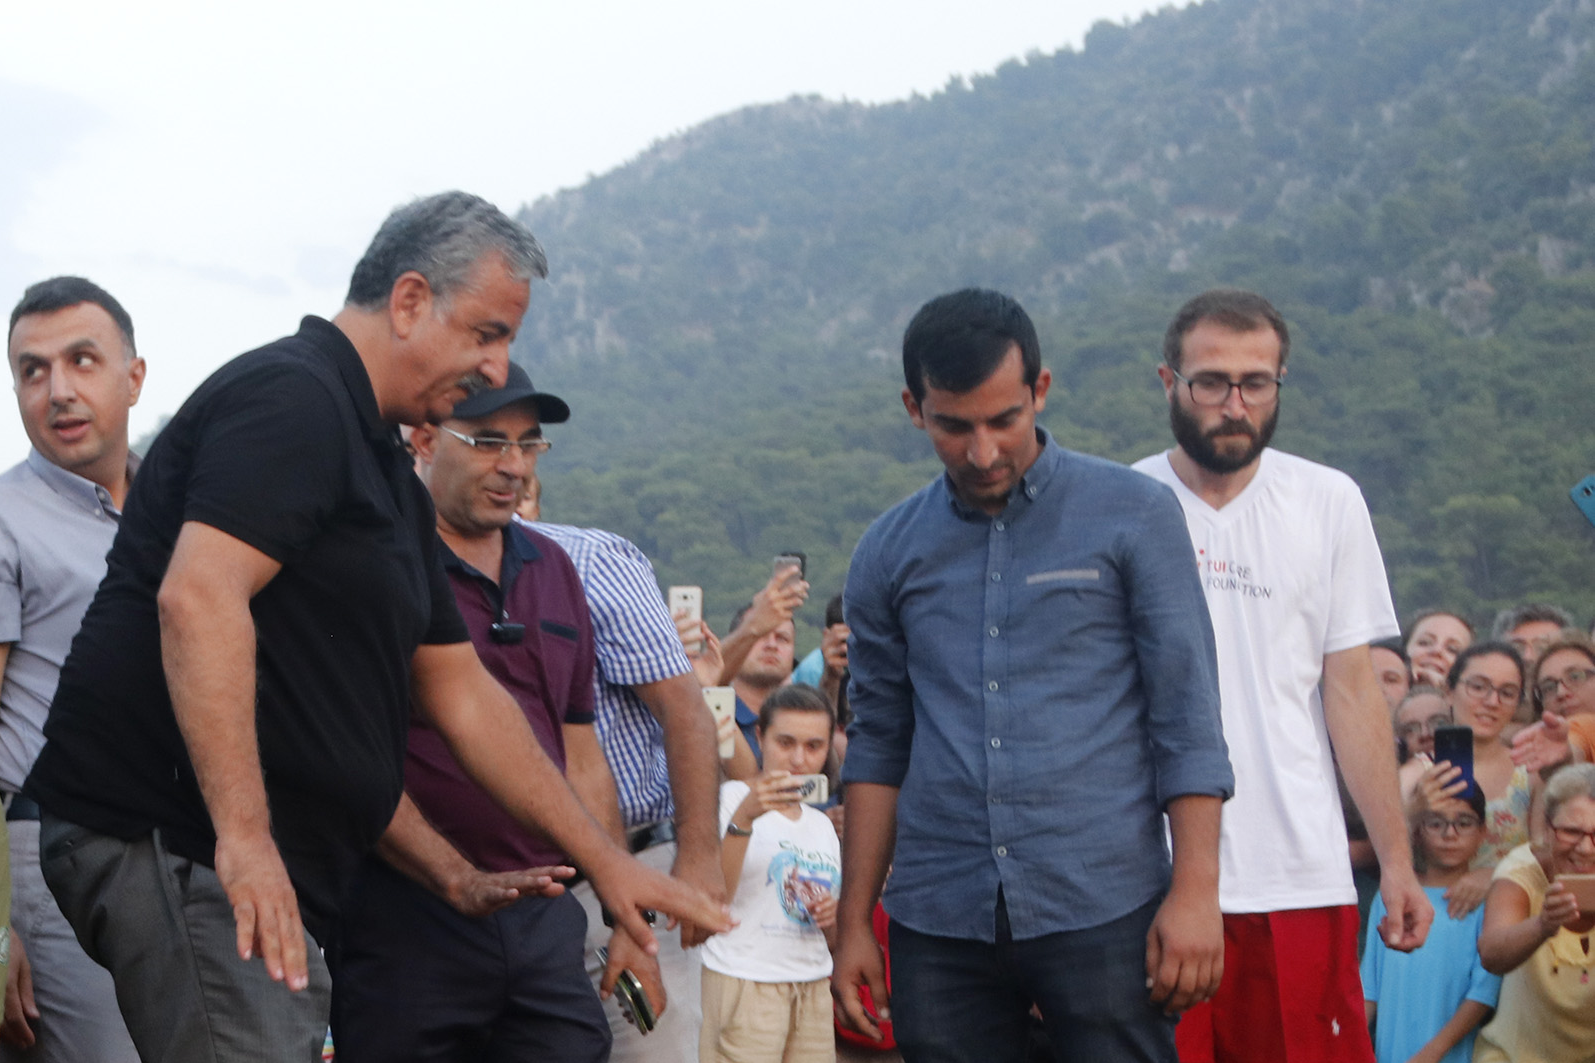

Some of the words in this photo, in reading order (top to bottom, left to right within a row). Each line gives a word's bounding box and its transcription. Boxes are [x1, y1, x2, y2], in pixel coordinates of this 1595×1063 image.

[1207, 560, 1227, 573] TUI
[1229, 560, 1252, 579] CRE
[1207, 576, 1272, 599] FOUNTION
